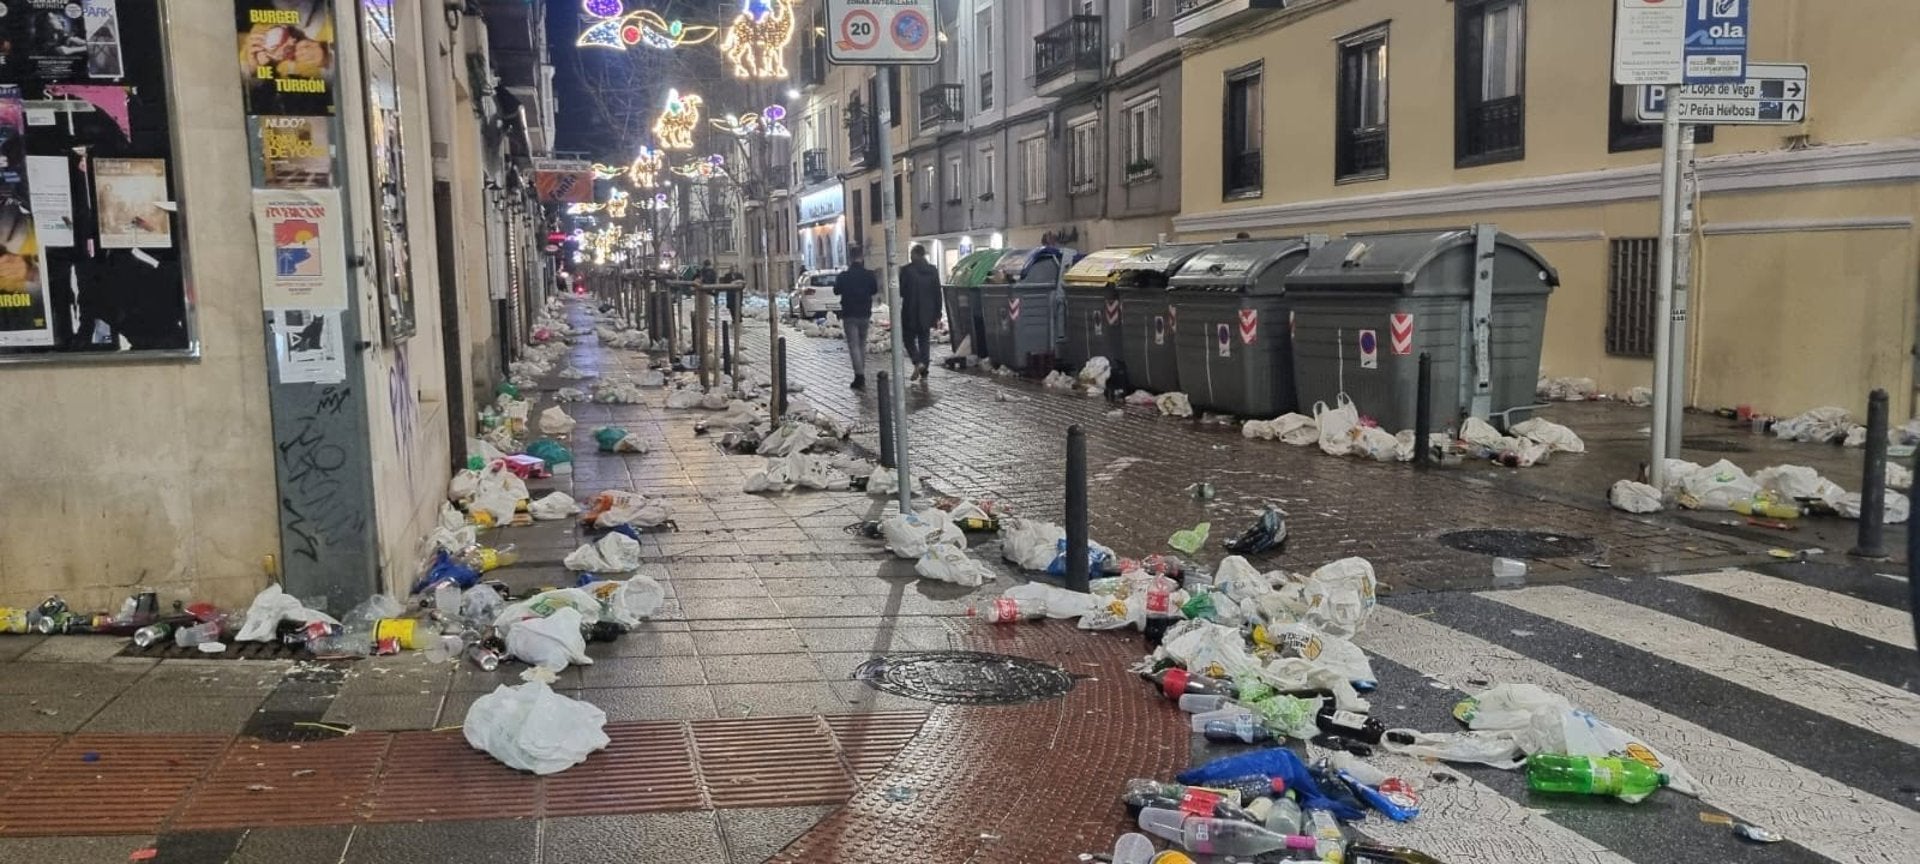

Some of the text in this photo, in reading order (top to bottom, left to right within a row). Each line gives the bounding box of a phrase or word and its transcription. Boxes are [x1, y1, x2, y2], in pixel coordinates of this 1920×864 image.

[250, 10, 299, 24] BURGER
[851, 22, 871, 36] 20
[1709, 22, 1745, 38] ola
[257, 66, 274, 79] DE
[275, 77, 325, 93] TURRÓN
[1692, 85, 1716, 97] Lope
[1718, 85, 1730, 95] de
[1733, 85, 1755, 98] Vega
[1690, 103, 1714, 117] Peña
[1716, 103, 1755, 117] Herbosa
